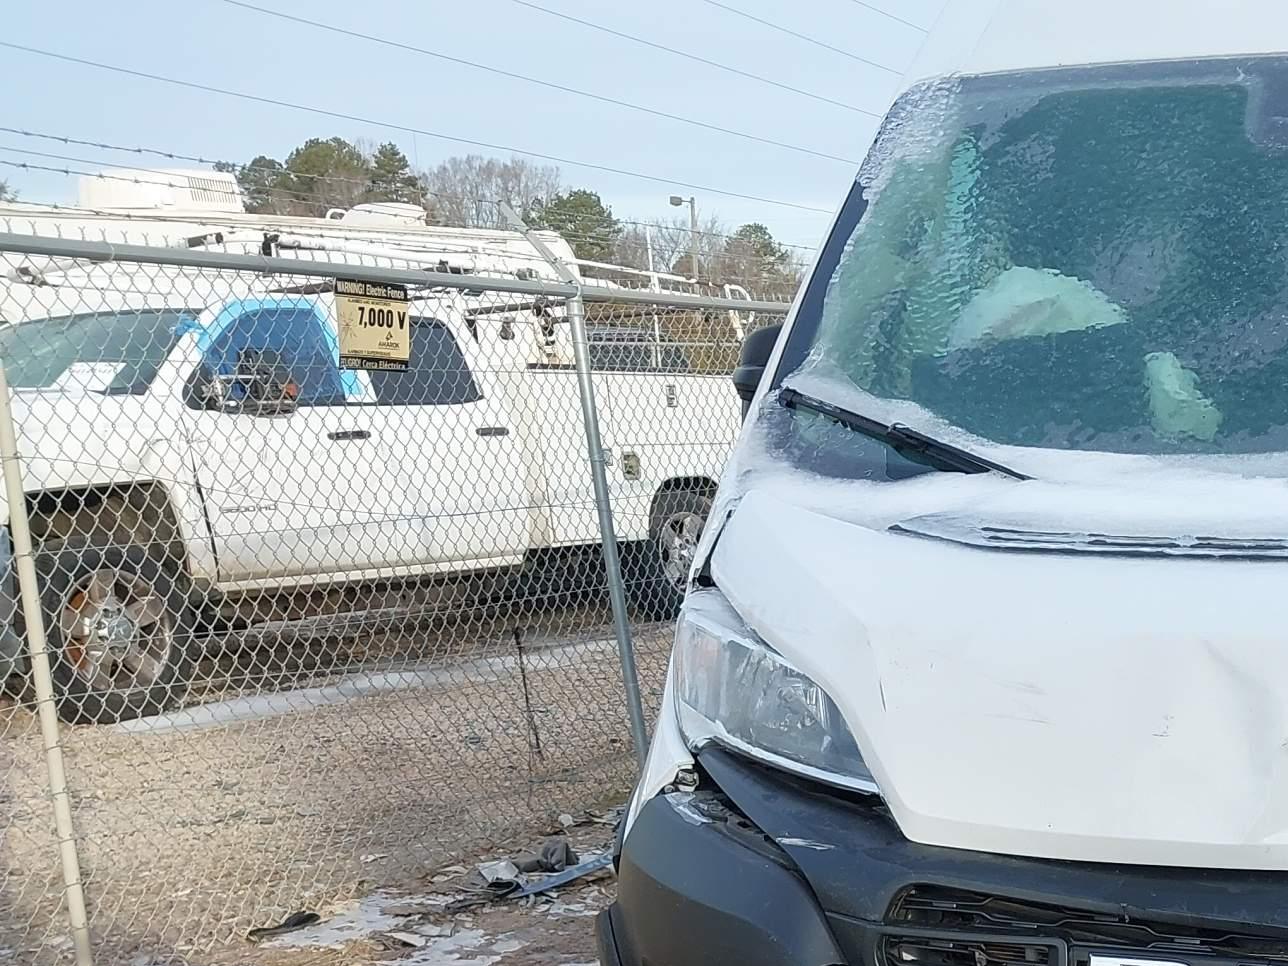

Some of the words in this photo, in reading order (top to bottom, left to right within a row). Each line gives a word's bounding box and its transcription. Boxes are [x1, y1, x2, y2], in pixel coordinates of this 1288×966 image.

[336, 280, 365, 295] WARNING!
[366, 284, 387, 297] Electric
[387, 287, 405, 299] Fence
[357, 306, 394, 329] 7,000
[397, 310, 406, 330] V
[362, 359, 378, 369] Cerca
